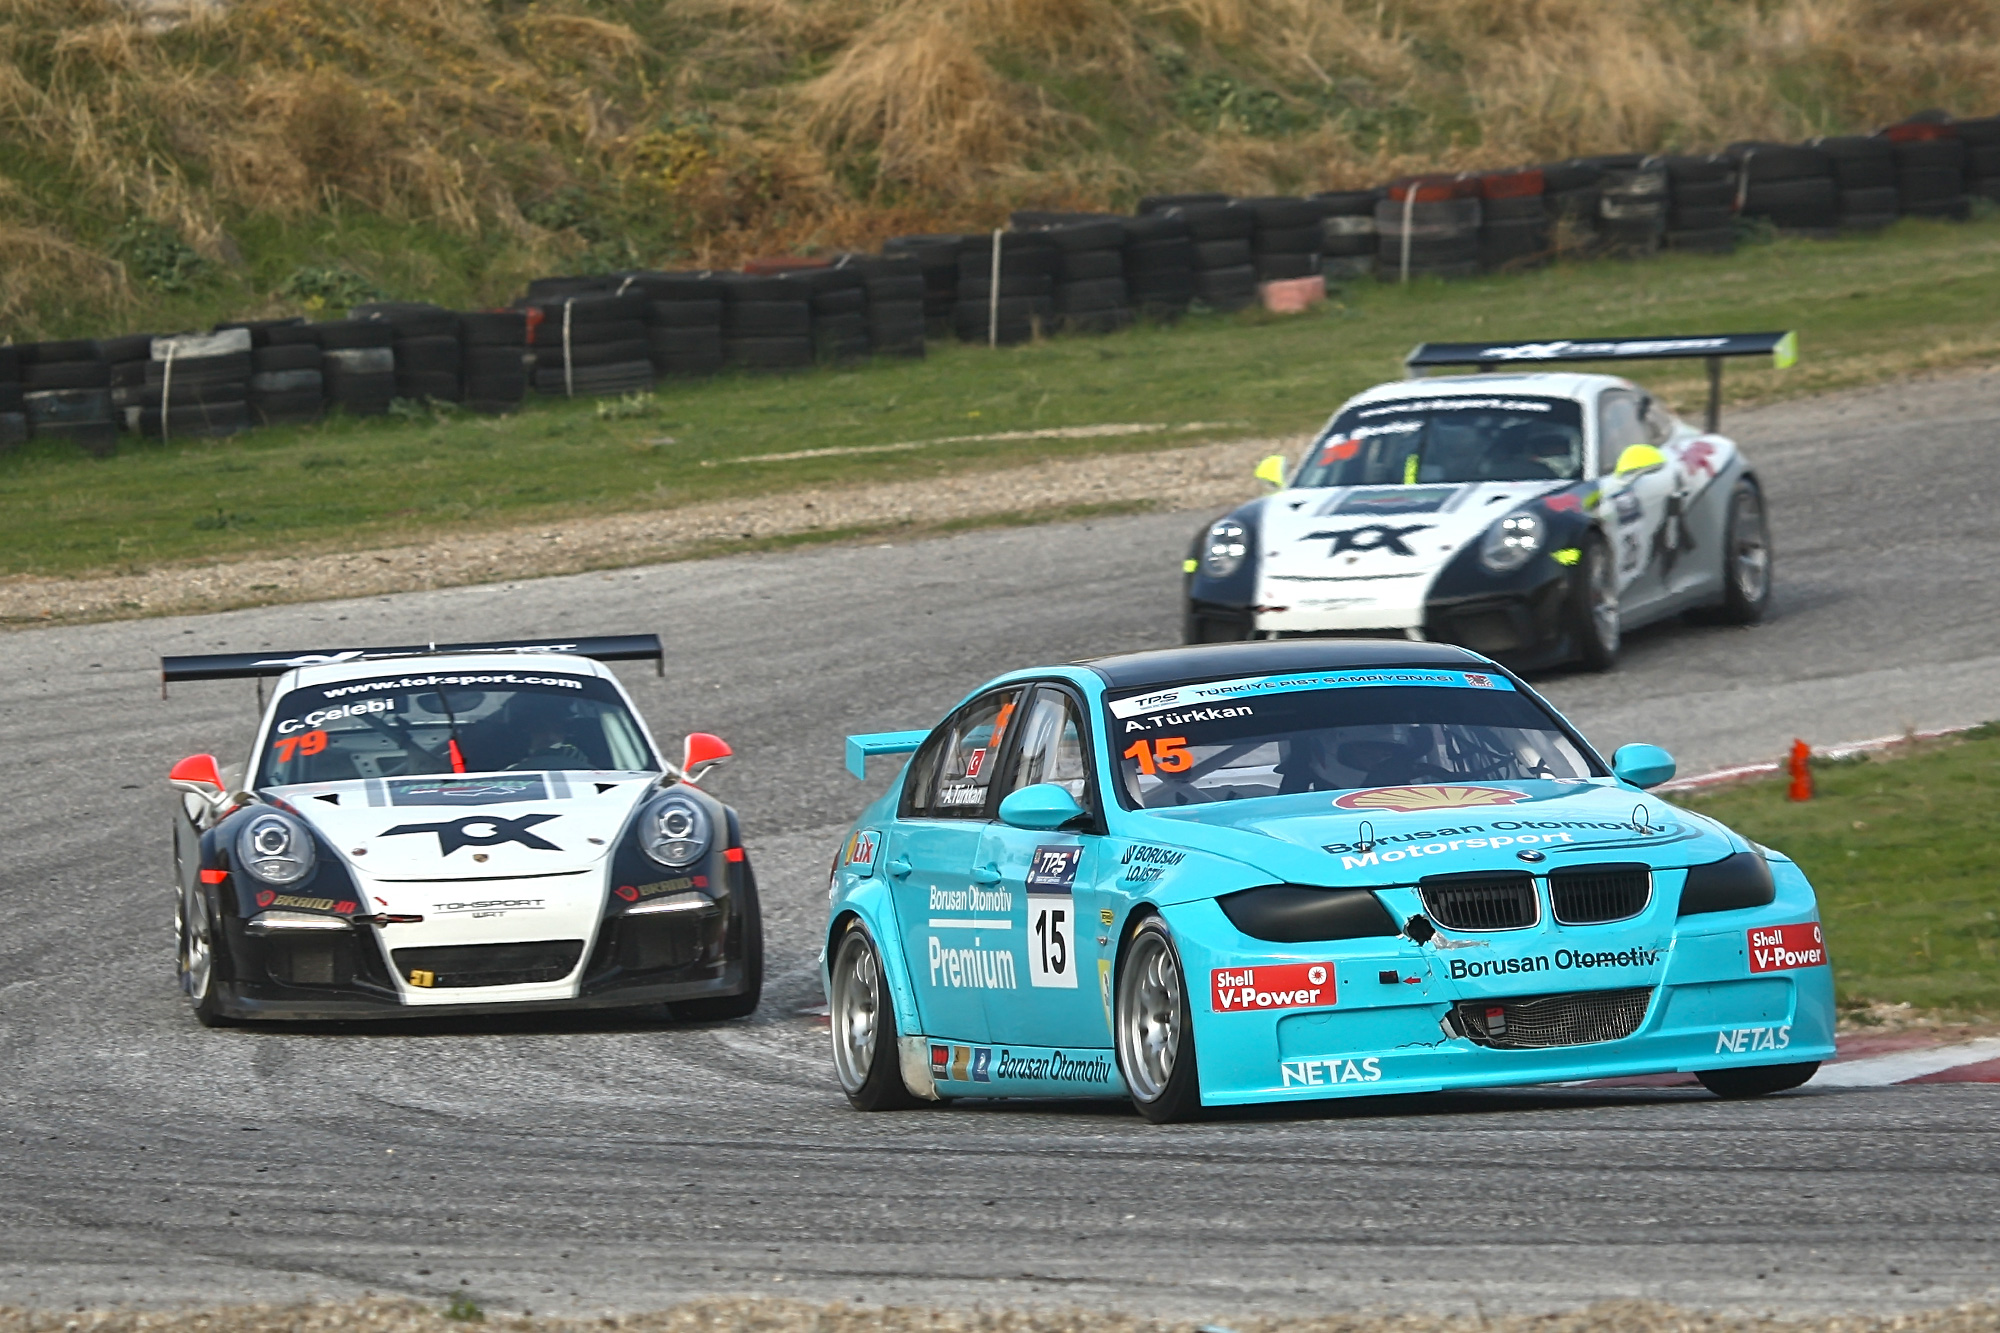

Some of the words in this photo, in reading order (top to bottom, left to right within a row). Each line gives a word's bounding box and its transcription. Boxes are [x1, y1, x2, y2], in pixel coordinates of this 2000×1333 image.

[323, 673, 583, 698] www.toksport.com
[1134, 691, 1179, 707] TPS
[277, 698, 395, 735] C.Çelebi
[1125, 704, 1253, 732] A.Türkkan
[274, 730, 328, 763] 79
[1123, 737, 1194, 776] 15
[943, 784, 983, 804] A.Türkkan
[1320, 824, 1484, 854] Borusan
[1341, 831, 1575, 870] Motorsport
[1039, 852, 1068, 873] TPS
[1134, 846, 1187, 866] BORUSAN
[929, 884, 967, 911] Borusan
[968, 884, 1012, 912] Otomotiv
[1035, 909, 1066, 974] 15
[1752, 929, 1783, 947] Shell
[929, 936, 1017, 989] Premium
[1449, 953, 1549, 980] Borusan
[1554, 946, 1657, 970] Otomotiv
[1753, 946, 1822, 970] V-Power
[1217, 969, 1254, 988] Shell
[1217, 987, 1321, 1009] V-Power
[997, 1049, 1049, 1080] Borusan
[1049, 1050, 1112, 1083] Otomotiv
